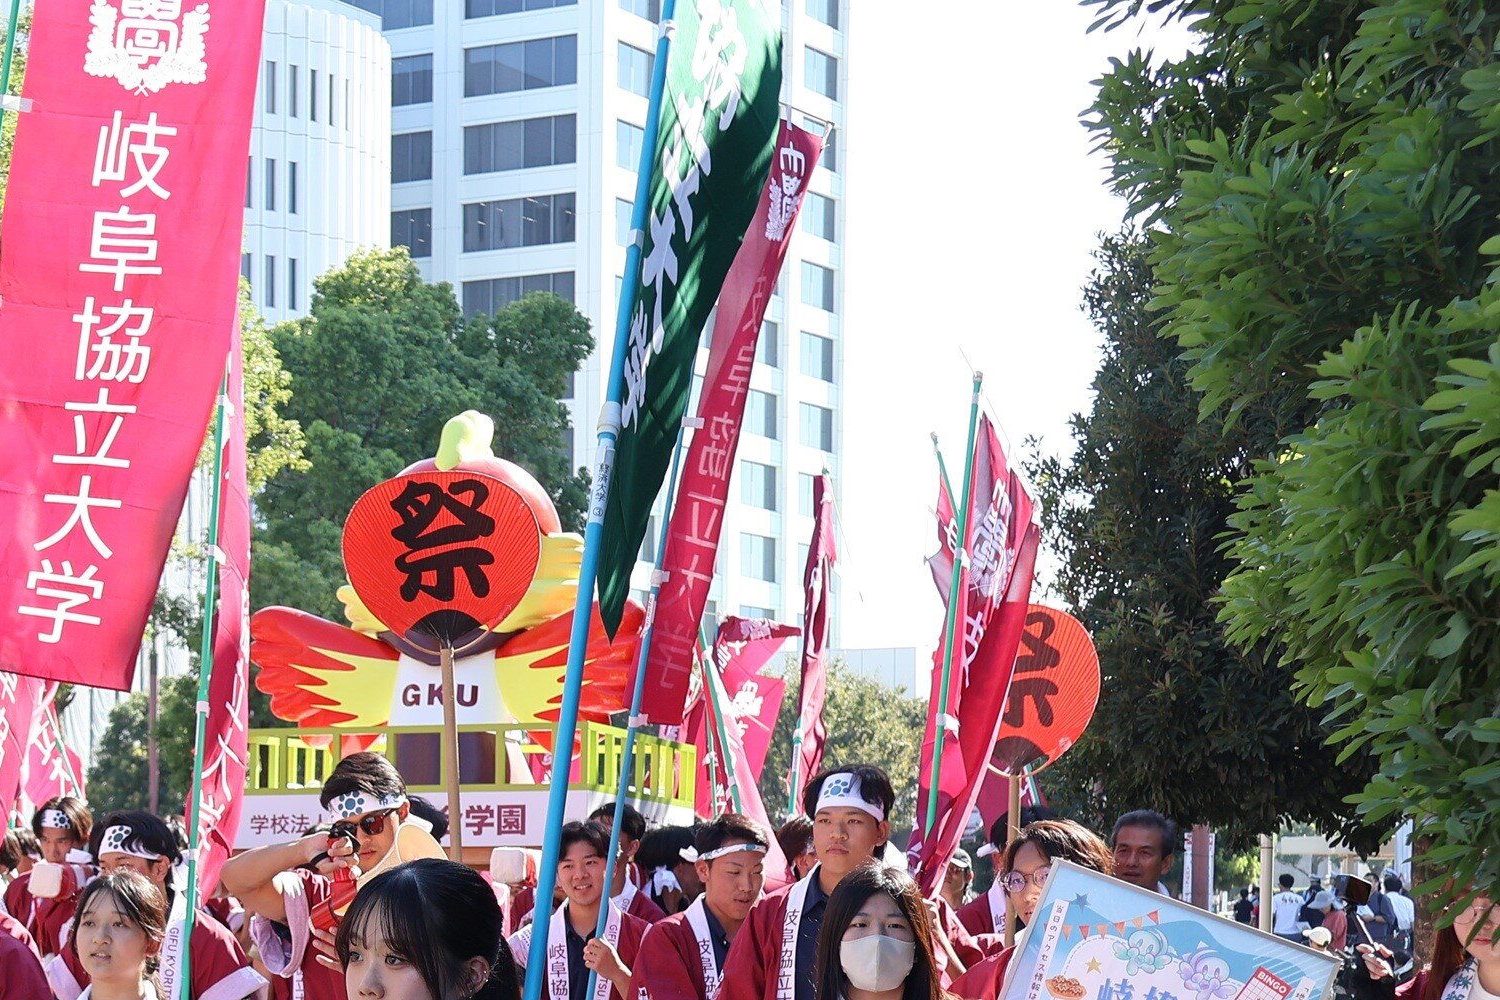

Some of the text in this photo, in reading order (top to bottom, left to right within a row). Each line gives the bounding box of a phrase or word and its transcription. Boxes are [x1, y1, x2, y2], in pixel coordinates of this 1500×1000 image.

[17, 109, 179, 645] 岐阜協立大学
[390, 478, 495, 602] 祭
[401, 683, 479, 708] GKU
[168, 927, 180, 953] GIFU
[1257, 971, 1287, 993] BINGO
